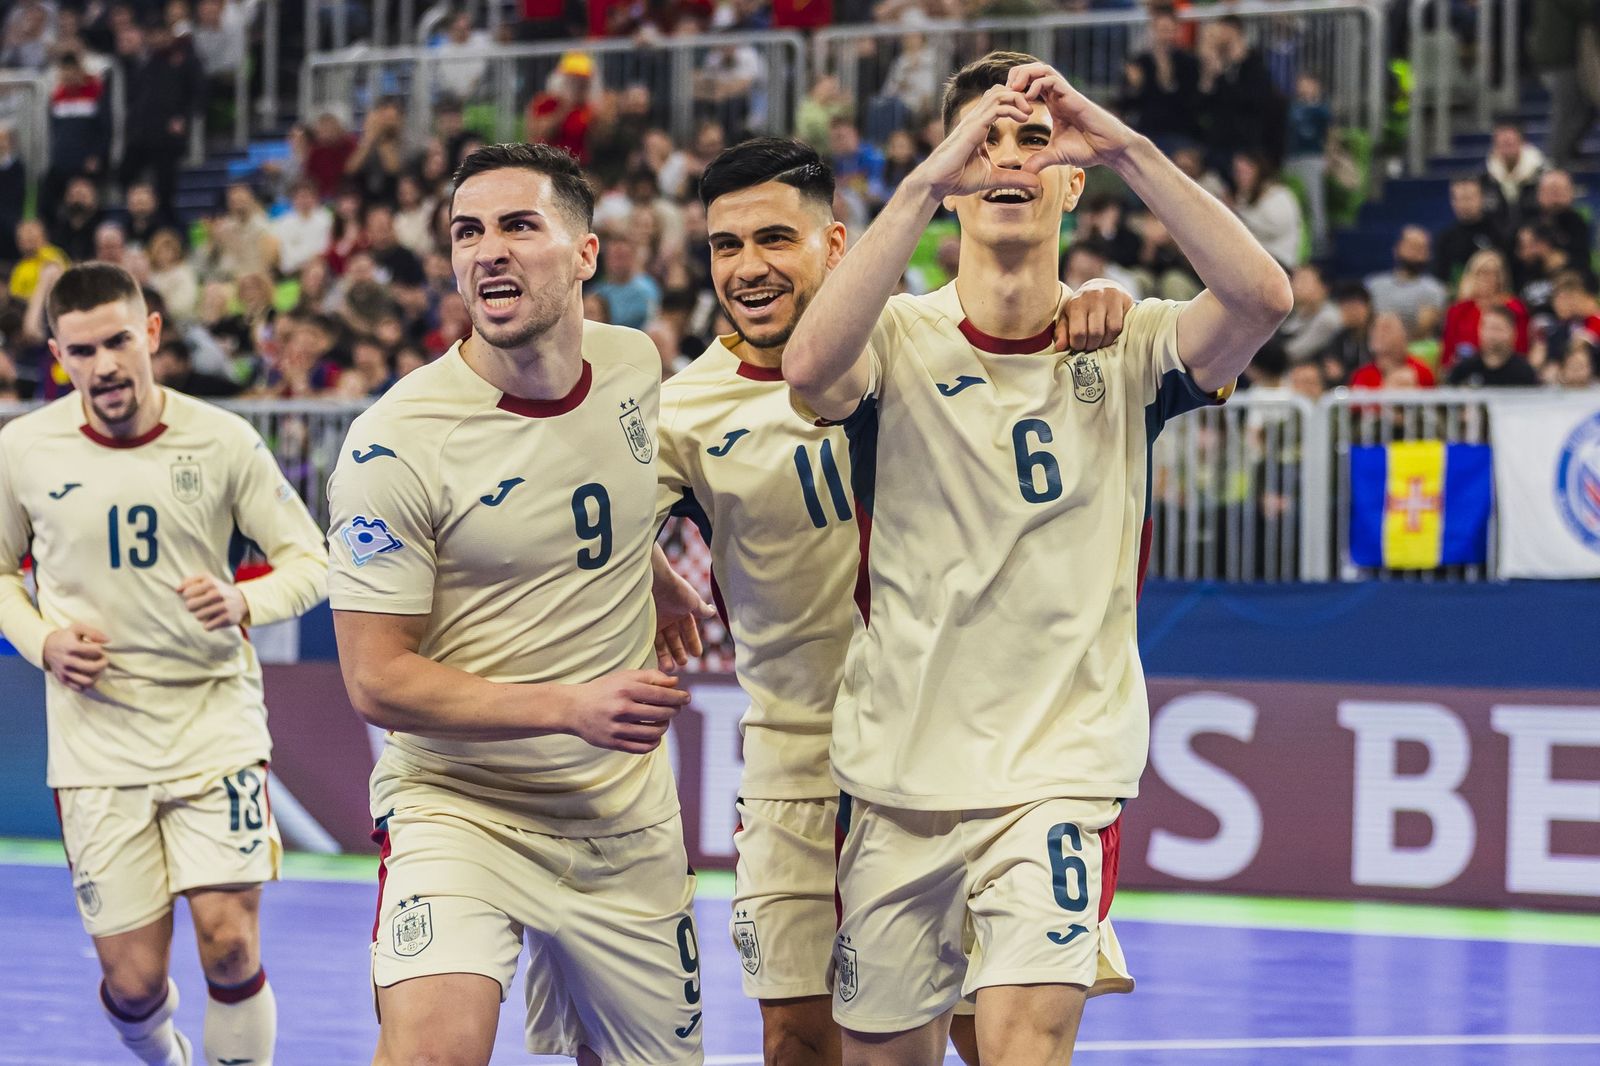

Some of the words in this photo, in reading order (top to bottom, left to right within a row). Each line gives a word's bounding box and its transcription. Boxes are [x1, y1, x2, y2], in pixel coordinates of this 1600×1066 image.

[793, 438, 853, 529] 11
[1012, 418, 1063, 504] 6
[108, 504, 158, 569] 13
[571, 482, 613, 570] 9
[223, 769, 263, 831] 13
[1047, 822, 1089, 912] 6
[676, 915, 701, 1005] 9
